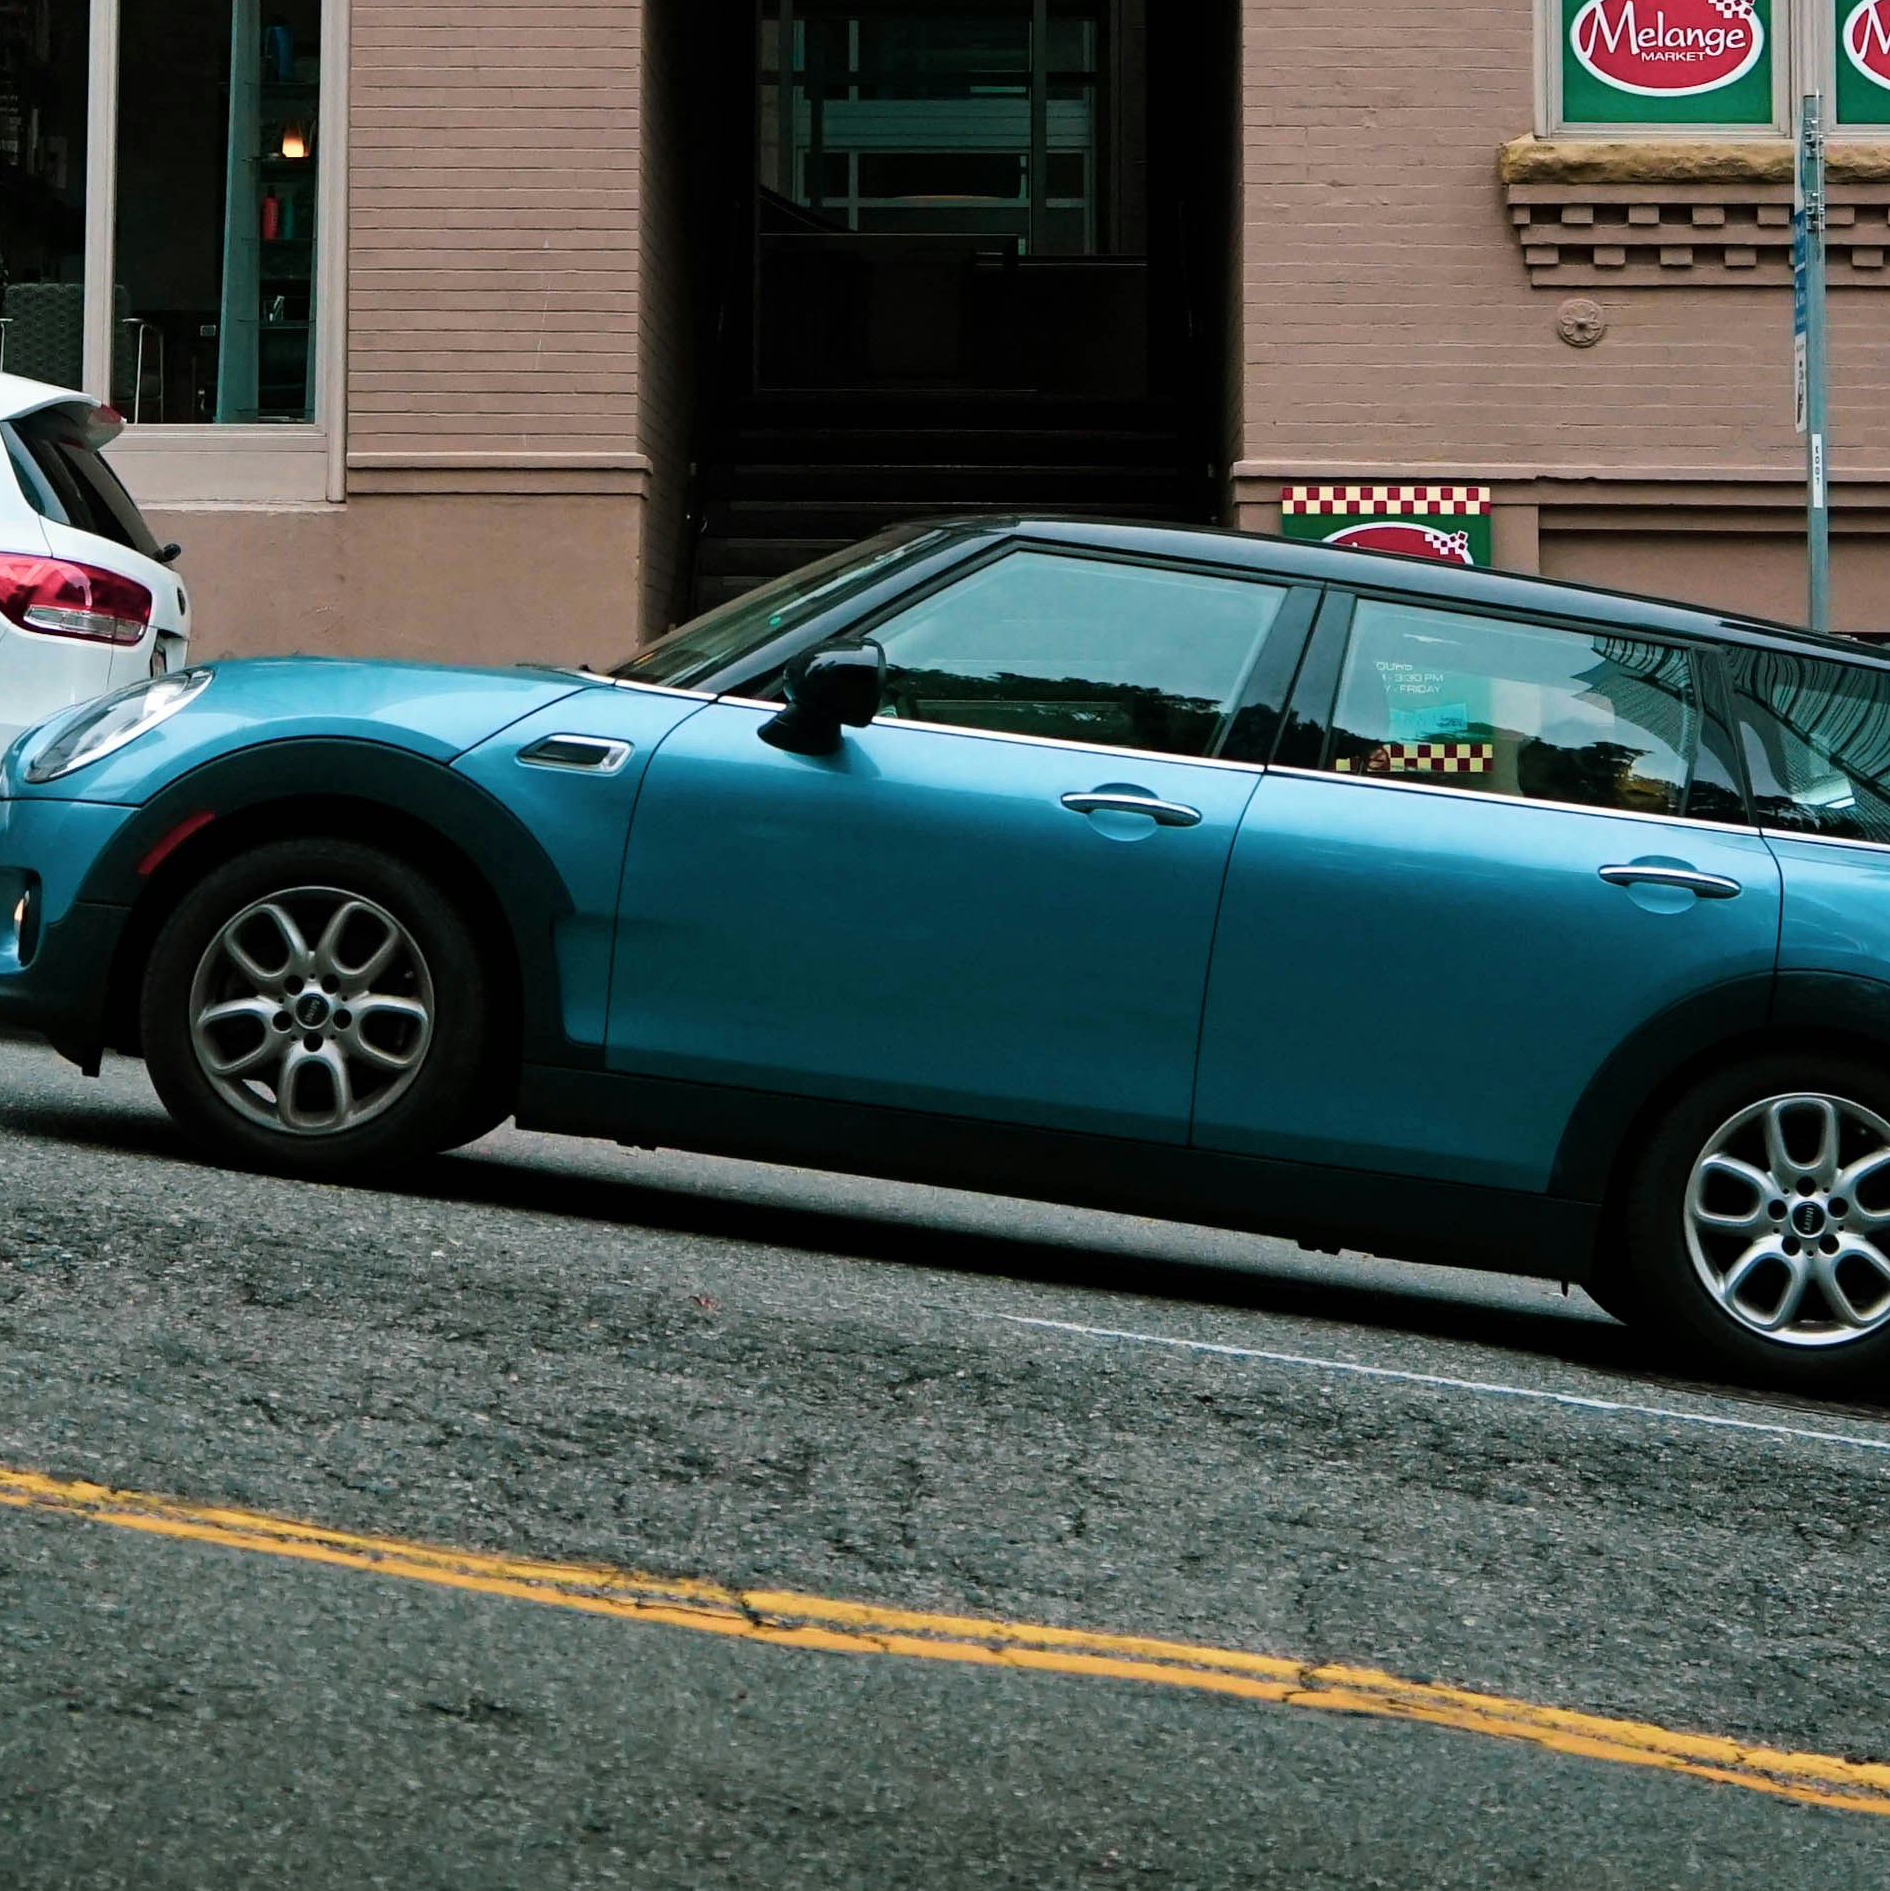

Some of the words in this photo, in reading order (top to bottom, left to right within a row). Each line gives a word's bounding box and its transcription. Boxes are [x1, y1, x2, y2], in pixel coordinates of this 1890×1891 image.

[1584, 0, 1747, 57] Melange
[1641, 51, 1706, 62] MARKET
[1424, 673, 1444, 683] PM
[1399, 684, 1440, 694] FRIDAY
